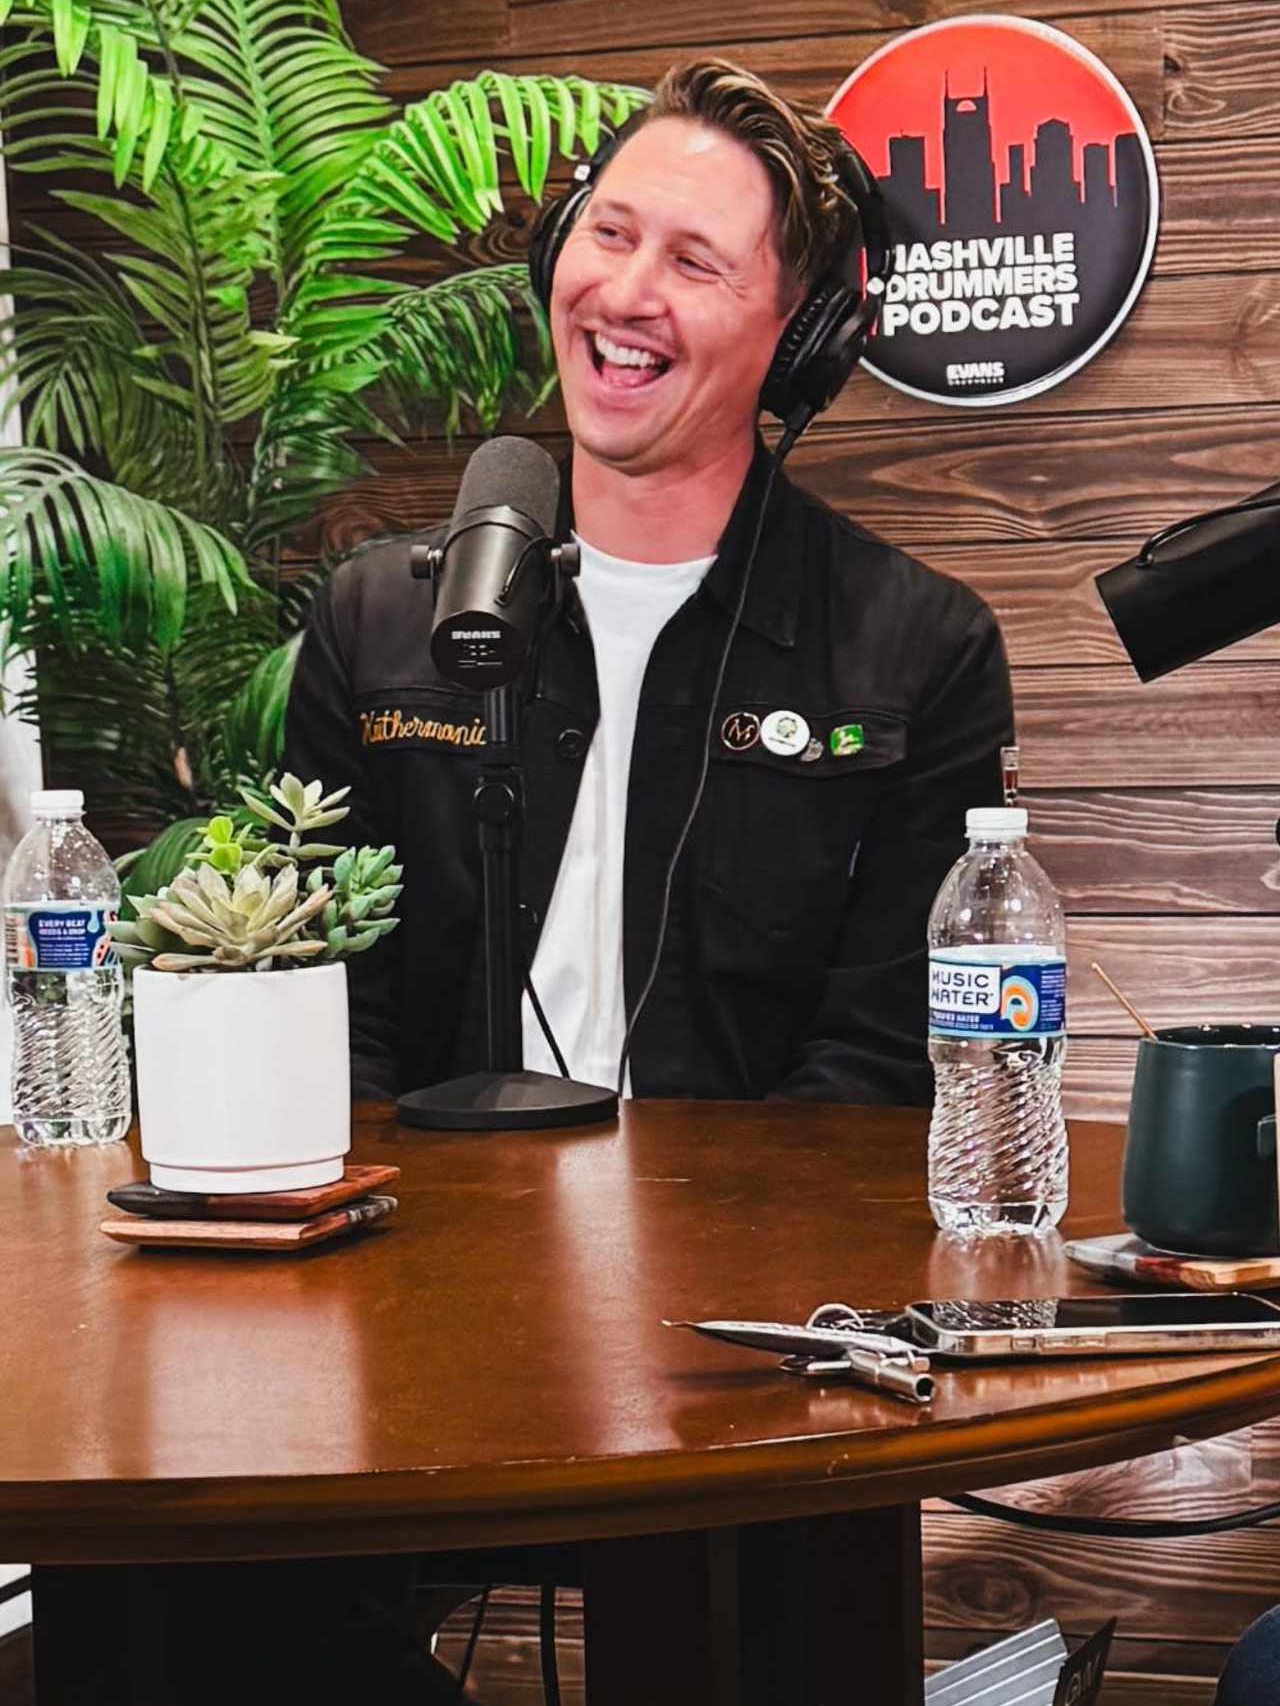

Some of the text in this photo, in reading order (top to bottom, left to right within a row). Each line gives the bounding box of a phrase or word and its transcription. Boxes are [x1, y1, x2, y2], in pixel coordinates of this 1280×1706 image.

[885, 263, 1079, 303] DRUMMERS
[882, 293, 1081, 337] PODCAST
[946, 361, 1006, 379] EVANS
[931, 969, 990, 989] MUSIC
[931, 987, 990, 1007] WATER
